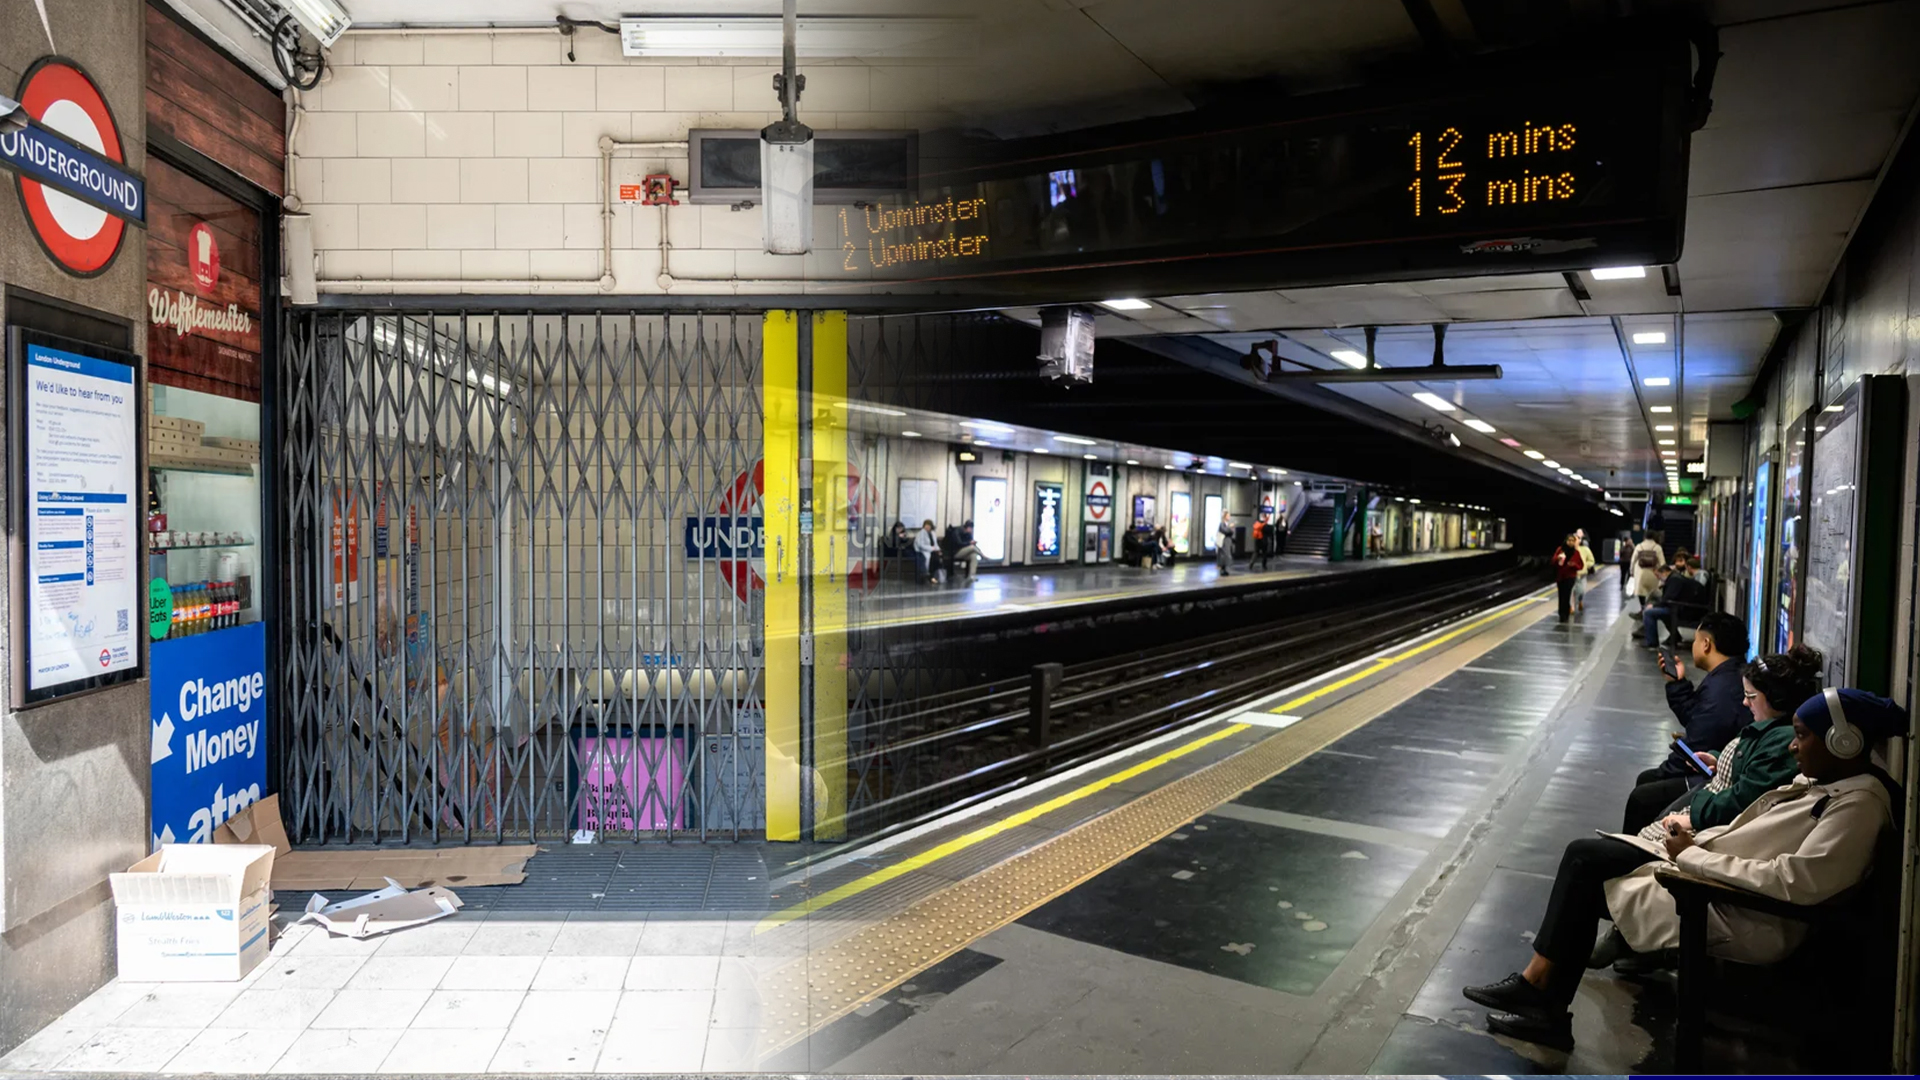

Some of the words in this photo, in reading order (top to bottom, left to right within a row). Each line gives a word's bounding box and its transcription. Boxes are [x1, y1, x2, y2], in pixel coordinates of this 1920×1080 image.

[0, 130, 139, 211] UNDERGROUND
[838, 208, 849, 236] 1
[865, 196, 987, 233] Upminster
[1488, 121, 1576, 158] mins
[842, 241, 858, 271] 2
[868, 232, 989, 267] Upminster
[1487, 169, 1575, 206] mins
[148, 287, 252, 338] Wafflemeister
[35, 353, 52, 363] London
[53, 357, 81, 369] Underground
[36, 380, 54, 393] We'd
[56, 384, 68, 395] like
[69, 387, 77, 397] to
[78, 387, 94, 399] hear
[94, 389, 111, 401] from
[111, 395, 123, 405] you
[149, 597, 167, 609] Uber
[150, 611, 167, 623] Eats
[179, 672, 263, 722] Change
[186, 720, 259, 774] Money
